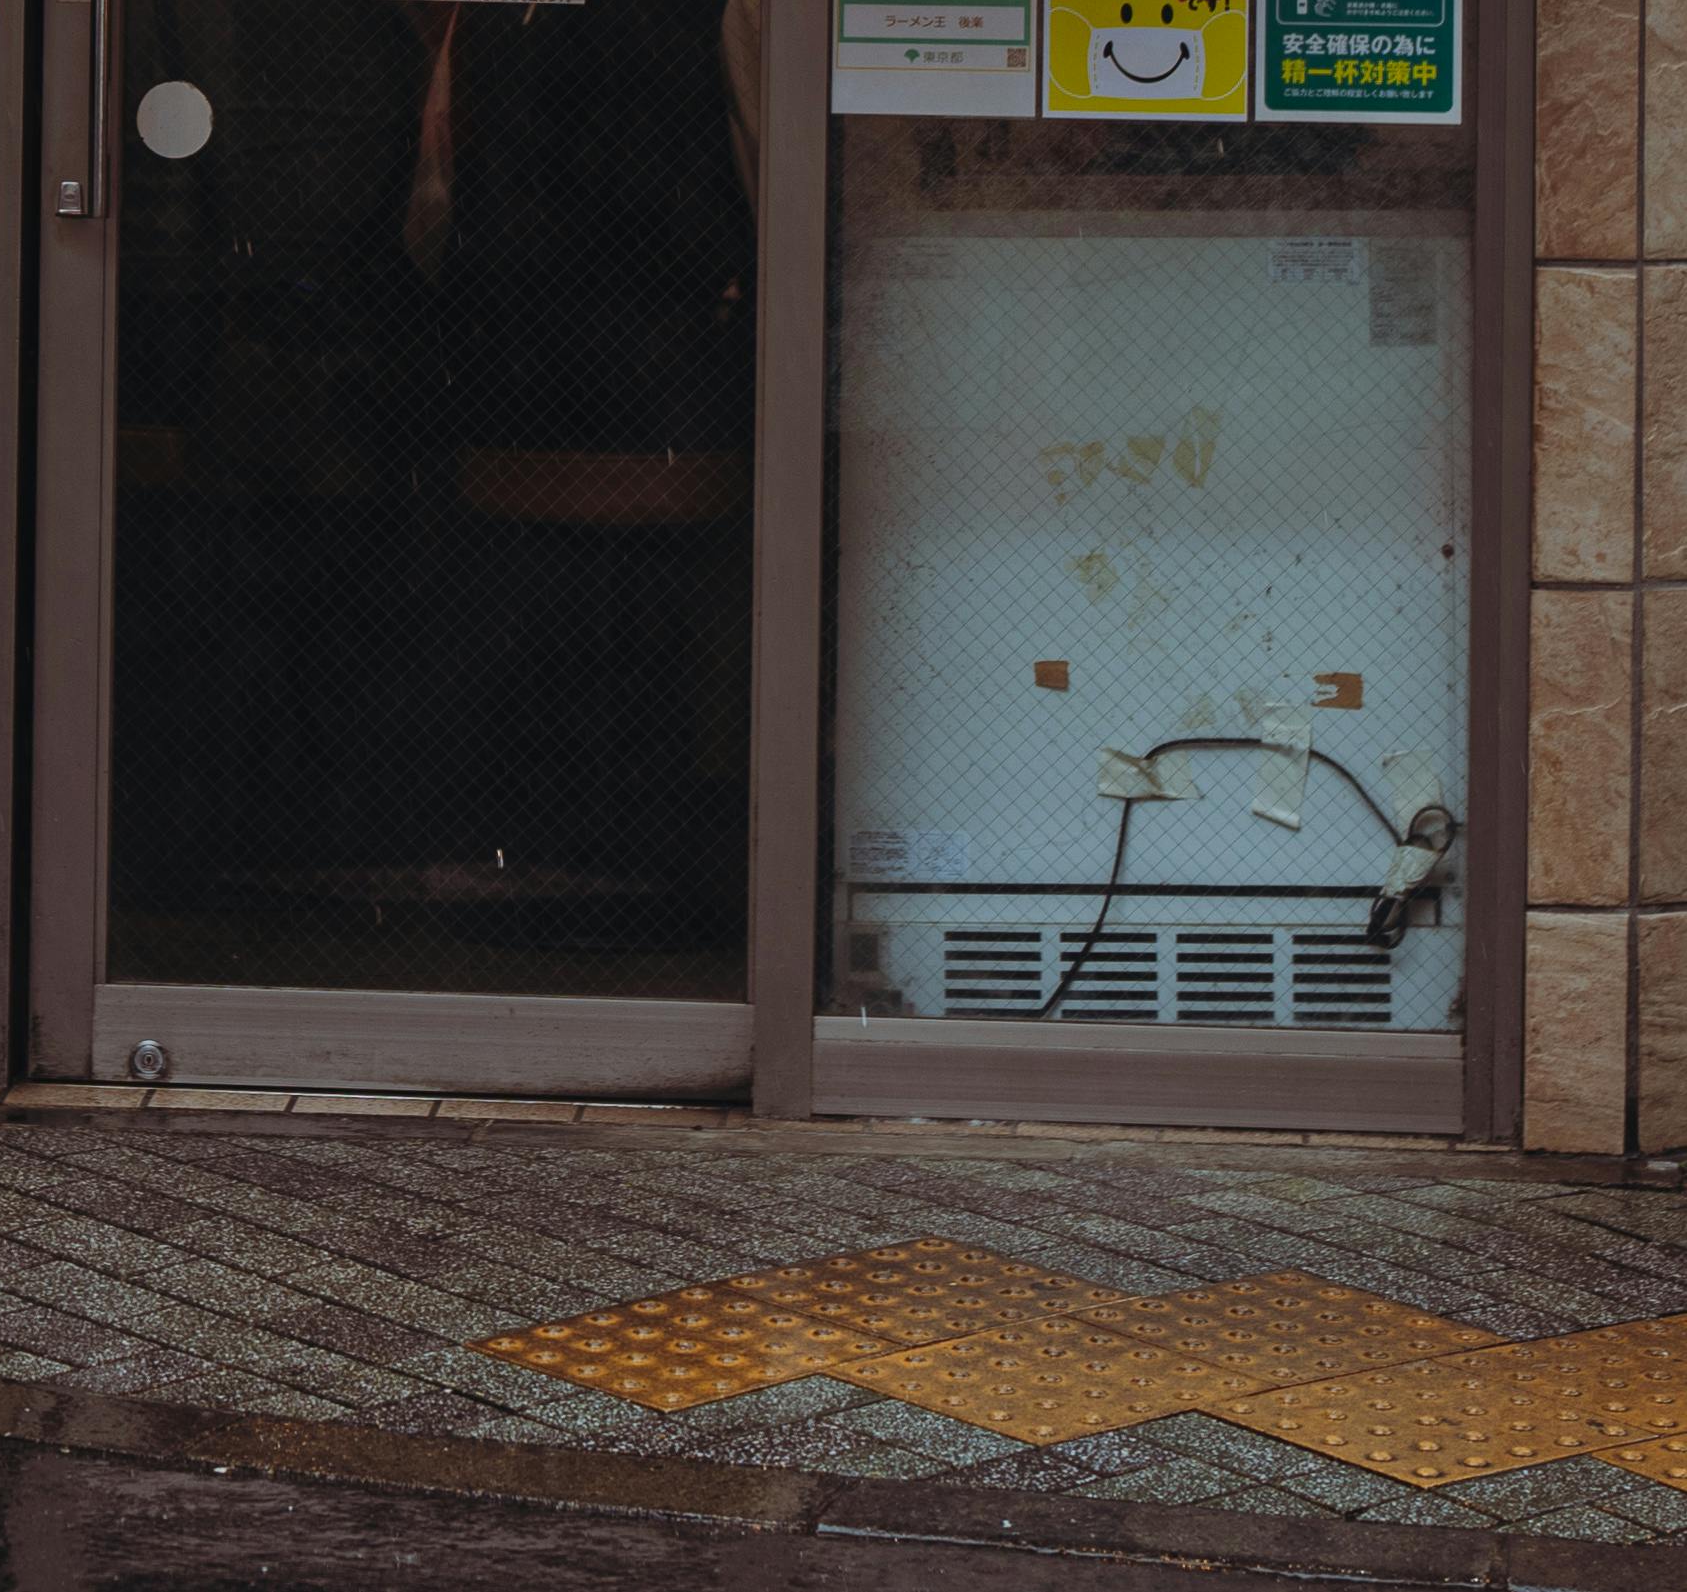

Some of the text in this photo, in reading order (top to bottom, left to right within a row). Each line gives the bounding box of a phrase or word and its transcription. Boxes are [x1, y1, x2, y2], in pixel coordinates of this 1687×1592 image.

[884, 14, 947, 28] ラーメン王
[1282, 32, 1437, 57] 安全確保の為に
[922, 50, 965, 64] 東京都
[1281, 57, 1439, 87] 精一杯対策中
